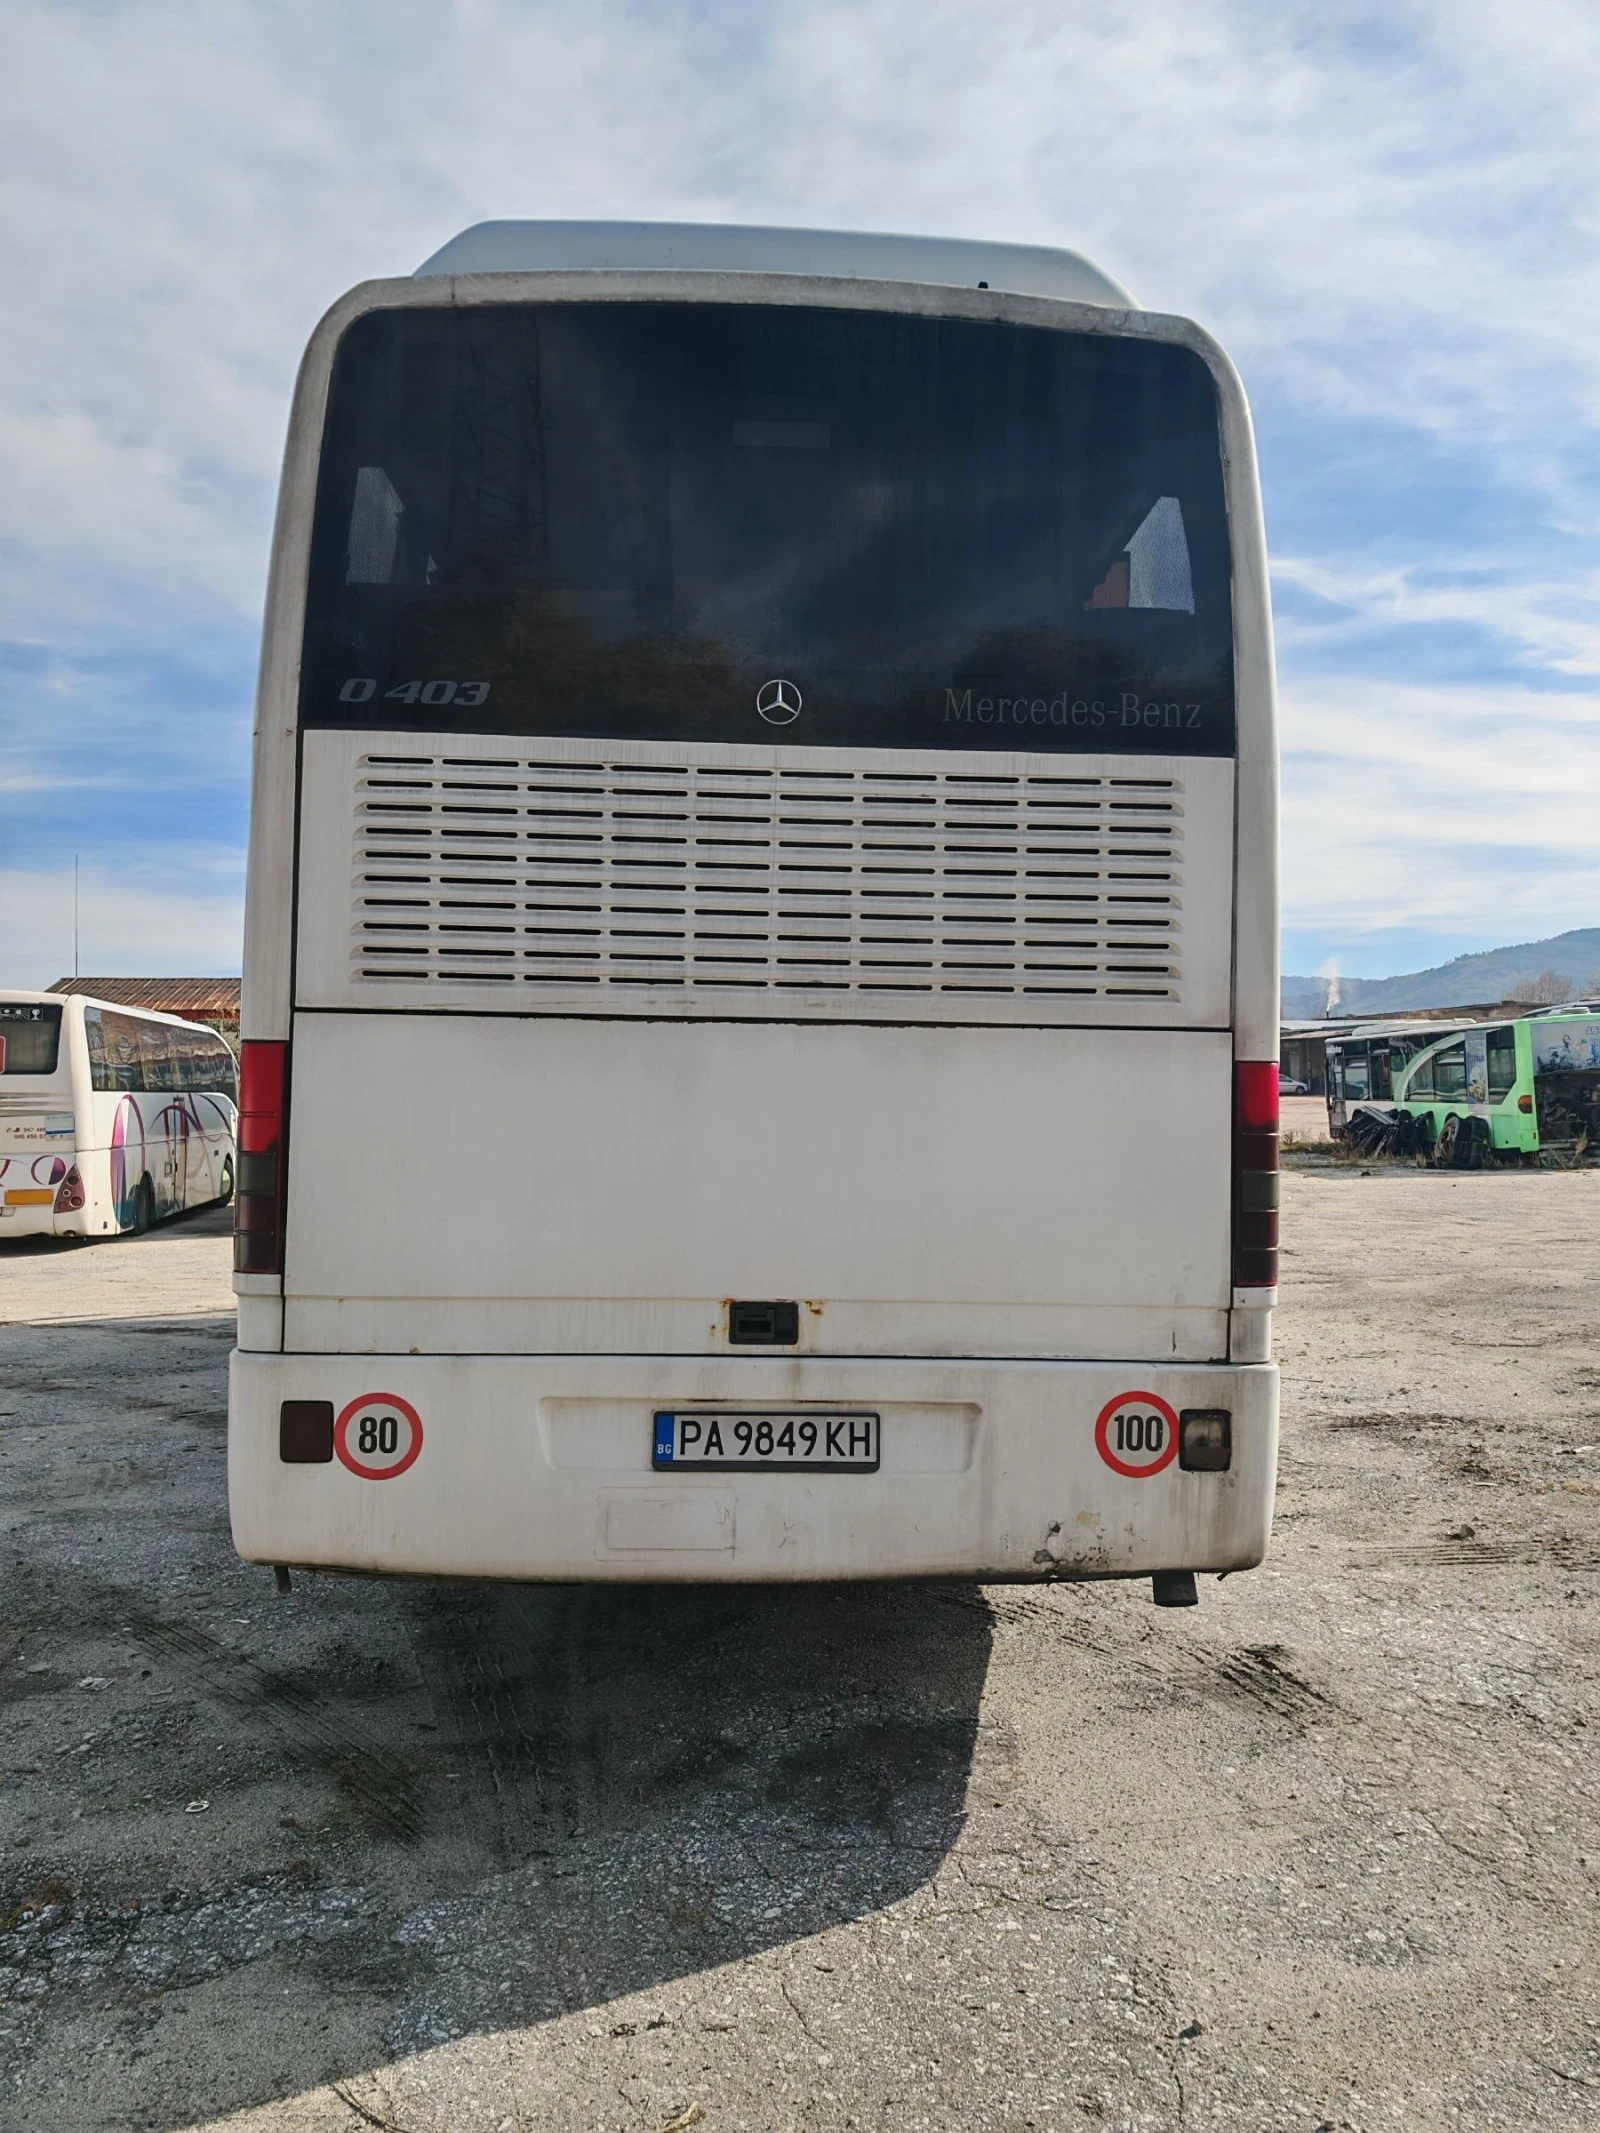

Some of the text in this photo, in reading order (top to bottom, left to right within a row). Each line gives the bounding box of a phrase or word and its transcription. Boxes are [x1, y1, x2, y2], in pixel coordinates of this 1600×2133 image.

[385, 680, 491, 706] 403
[941, 688, 1202, 728] Mercedes-Benz
[358, 1416, 398, 1454] 80
[657, 1443, 672, 1455] BG
[1114, 1415, 1164, 1452] 100
